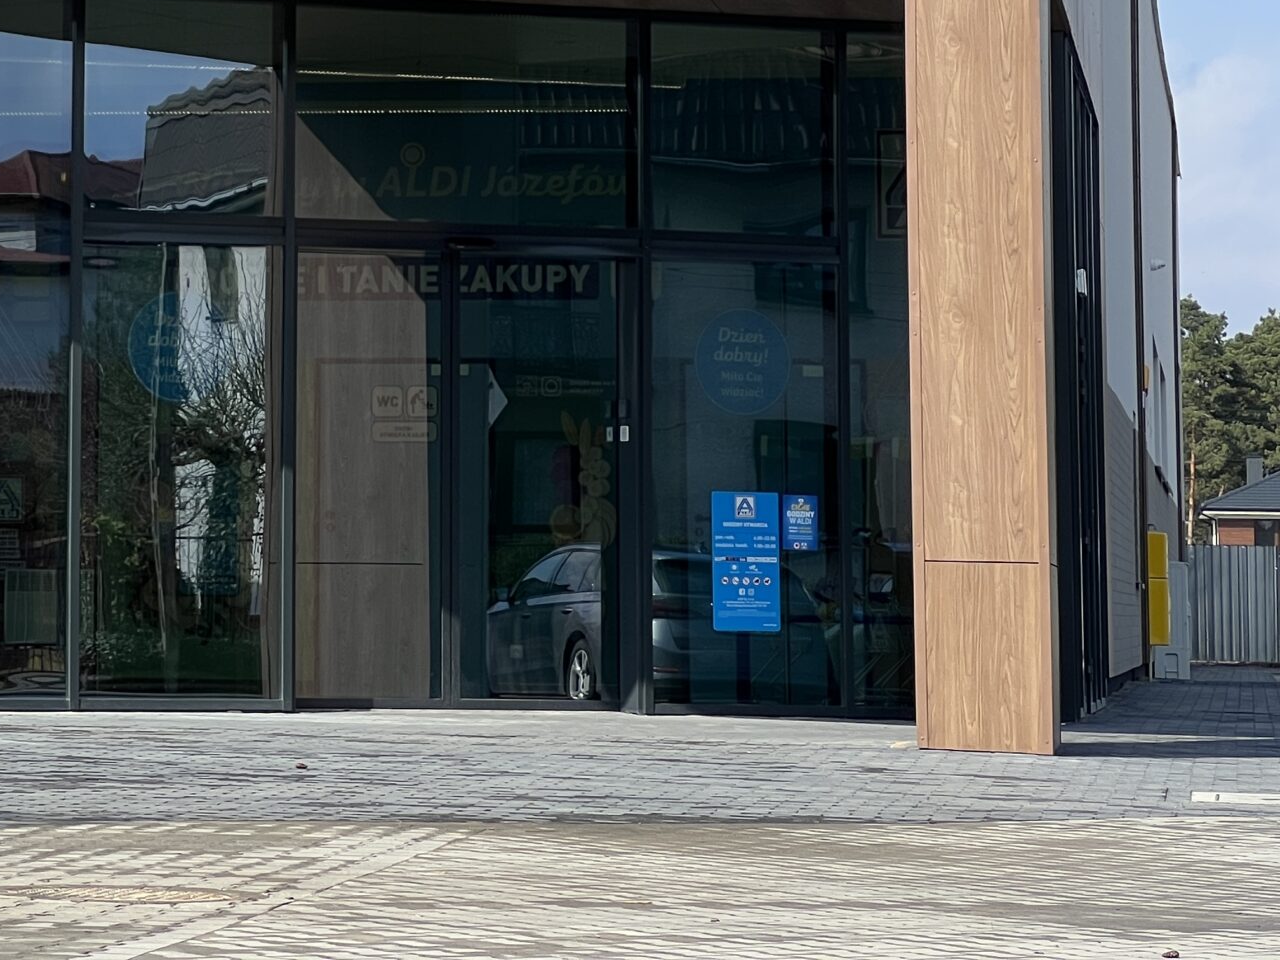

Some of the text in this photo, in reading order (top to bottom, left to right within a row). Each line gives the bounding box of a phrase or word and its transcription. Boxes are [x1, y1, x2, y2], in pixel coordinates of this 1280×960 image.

[376, 164, 472, 199] ALDI
[336, 264, 439, 294] TANIE
[713, 345, 769, 367] dobry!
[376, 395, 399, 407] WC
